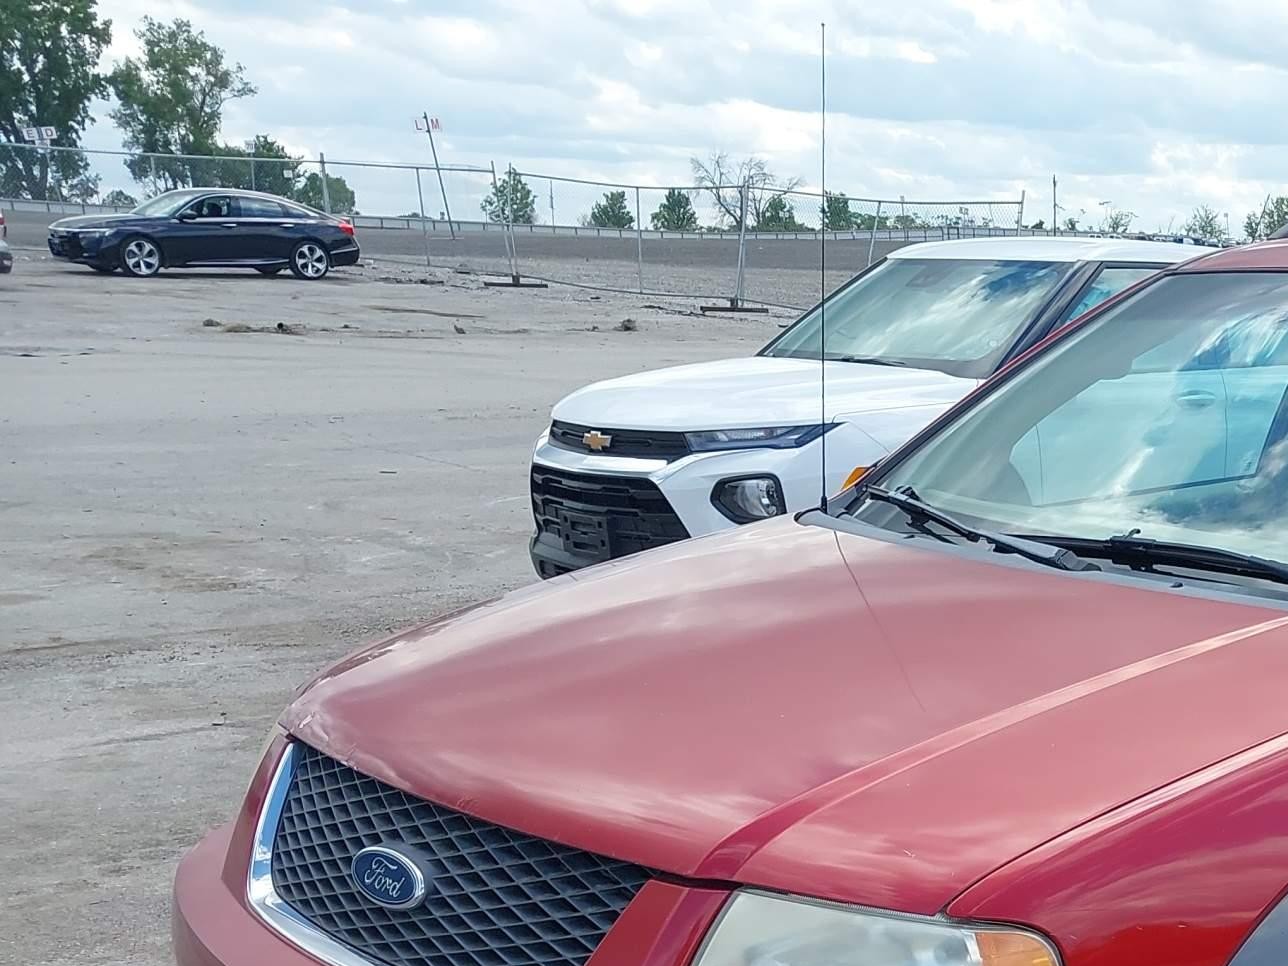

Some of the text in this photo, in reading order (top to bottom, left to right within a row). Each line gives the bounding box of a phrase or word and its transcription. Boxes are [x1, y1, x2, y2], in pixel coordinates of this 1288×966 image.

[415, 118, 440, 131] L M
[26, 128, 54, 139] E D
[364, 856, 406, 898] Ford
